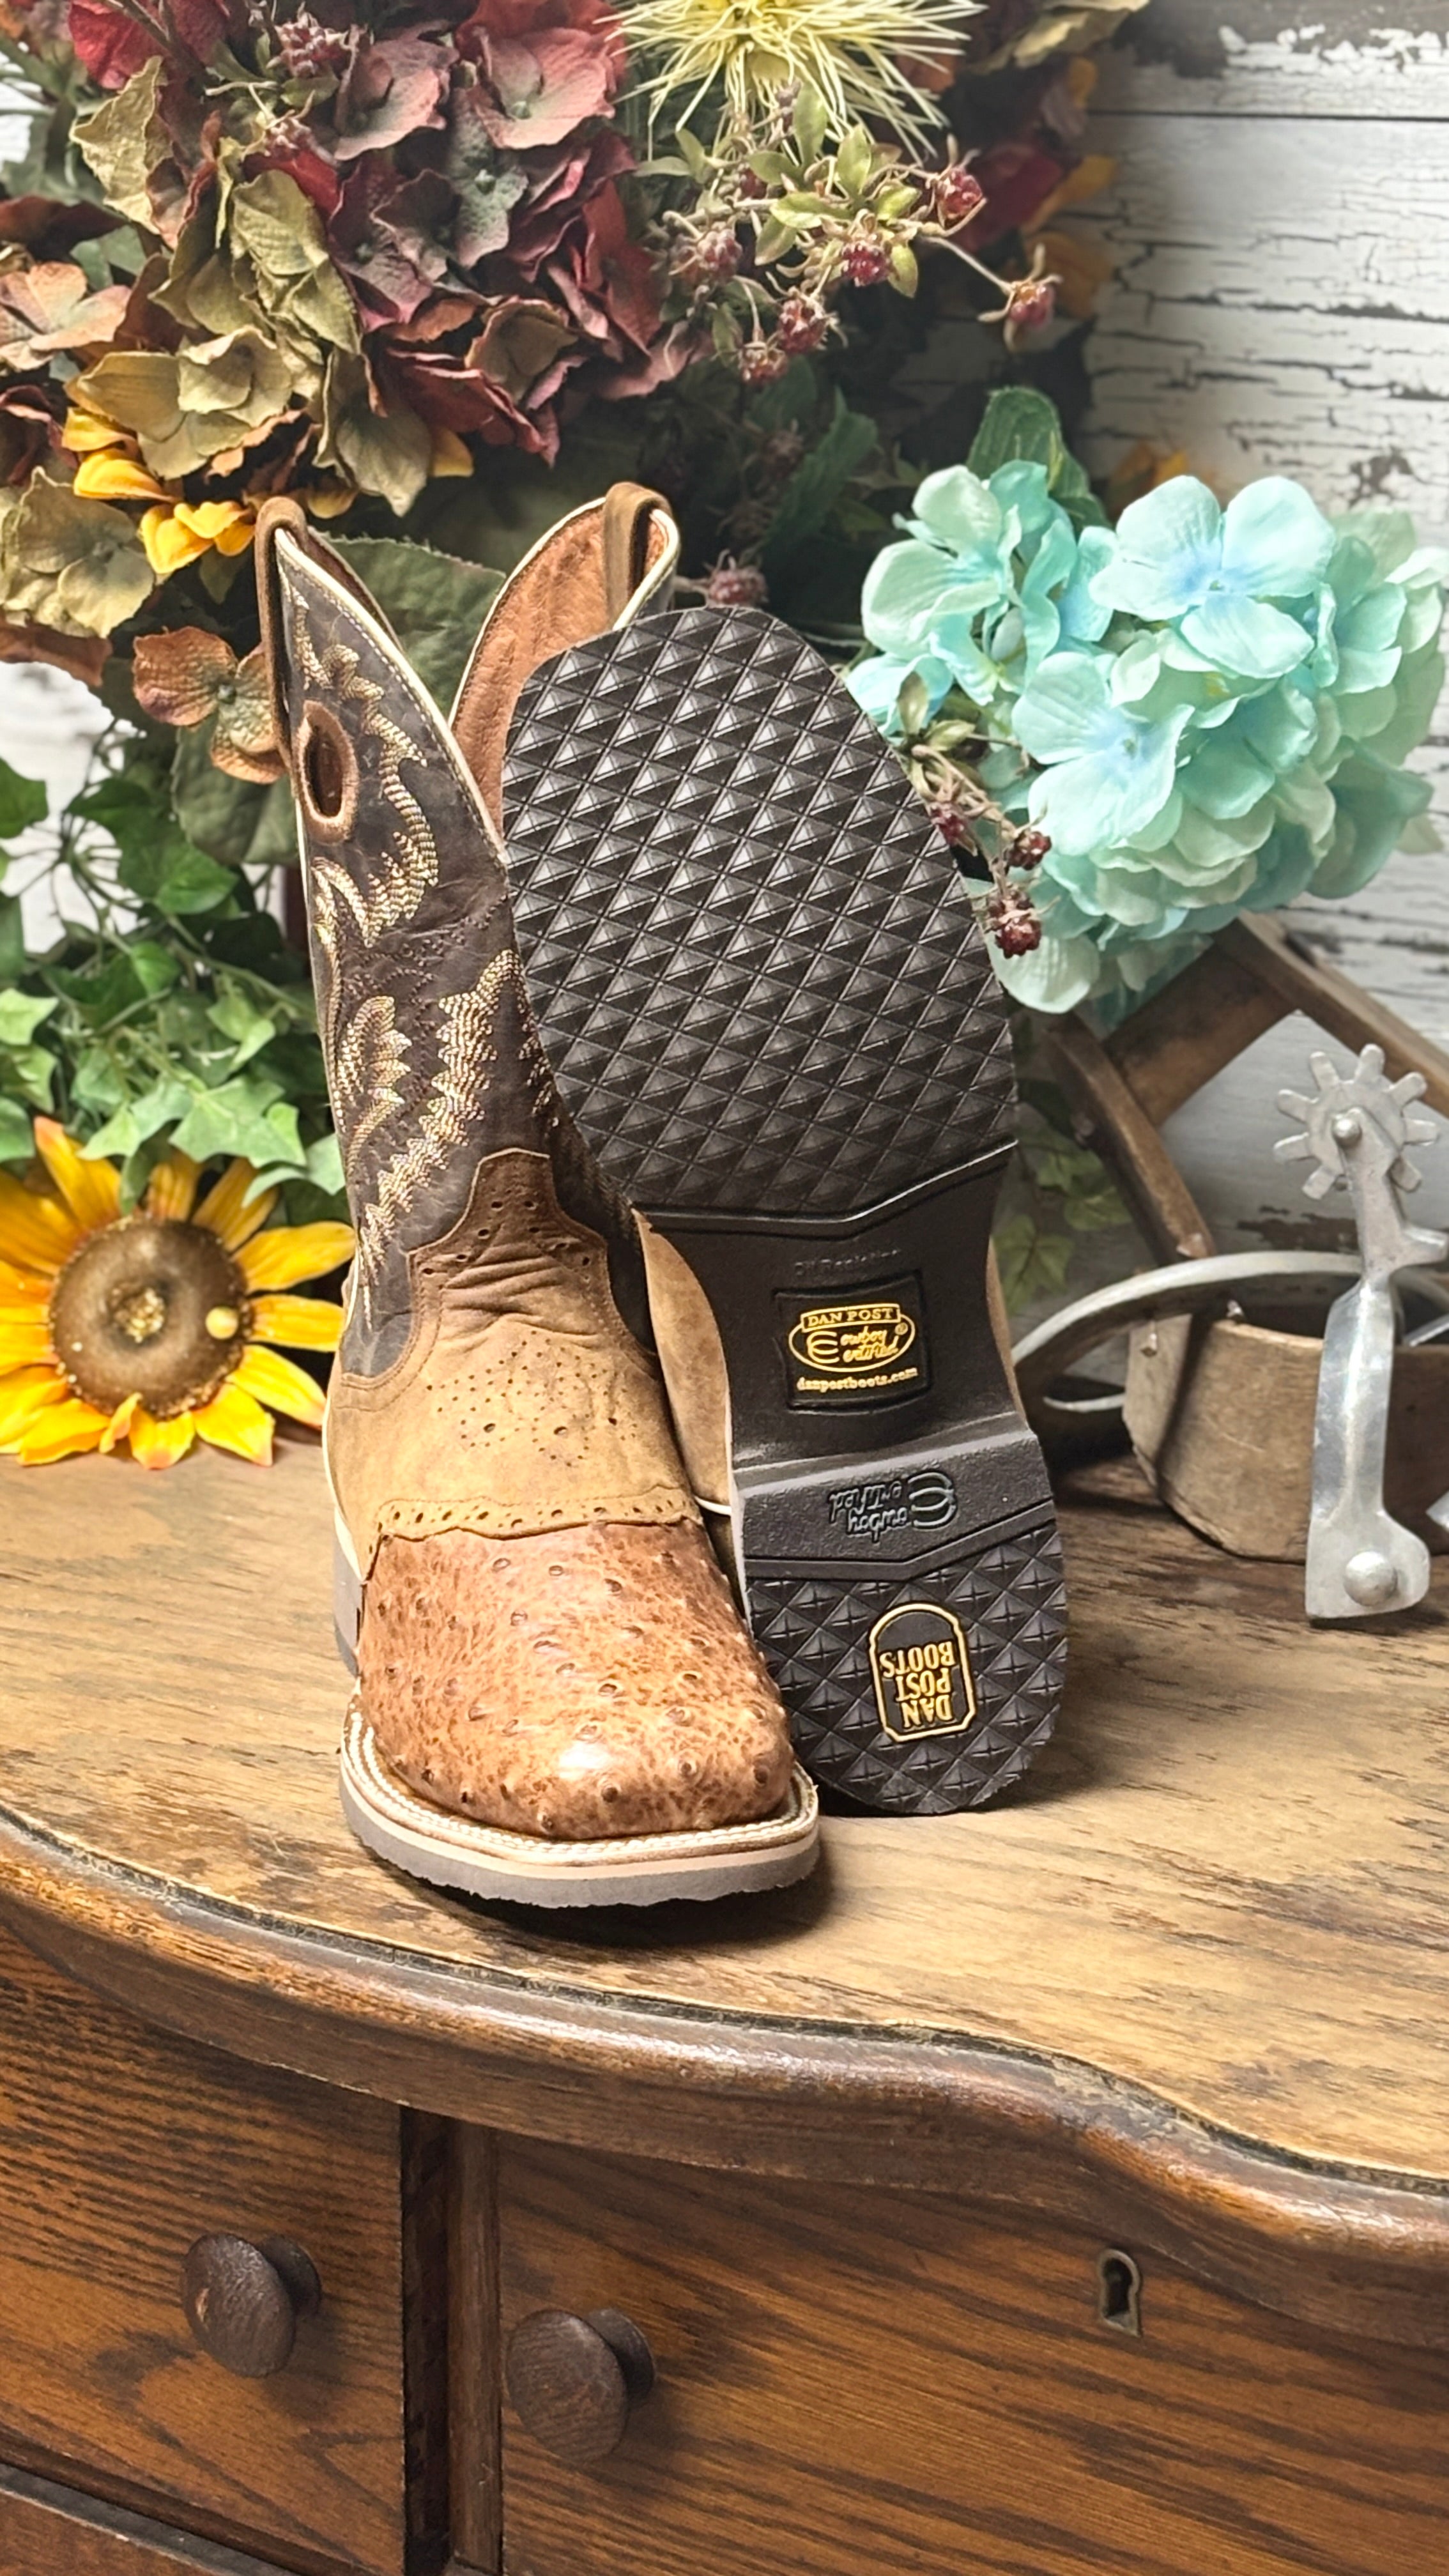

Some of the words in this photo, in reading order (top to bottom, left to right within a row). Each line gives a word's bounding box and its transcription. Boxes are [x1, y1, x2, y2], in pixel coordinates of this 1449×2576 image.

[808, 1312, 842, 1327] DAN
[847, 1308, 893, 1322] POST
[797, 1367, 918, 1393] danpostboots.com
[879, 1641, 956, 1678] BOOTS
[895, 1667, 951, 1702] POST
[901, 1694, 954, 1728] DAN
